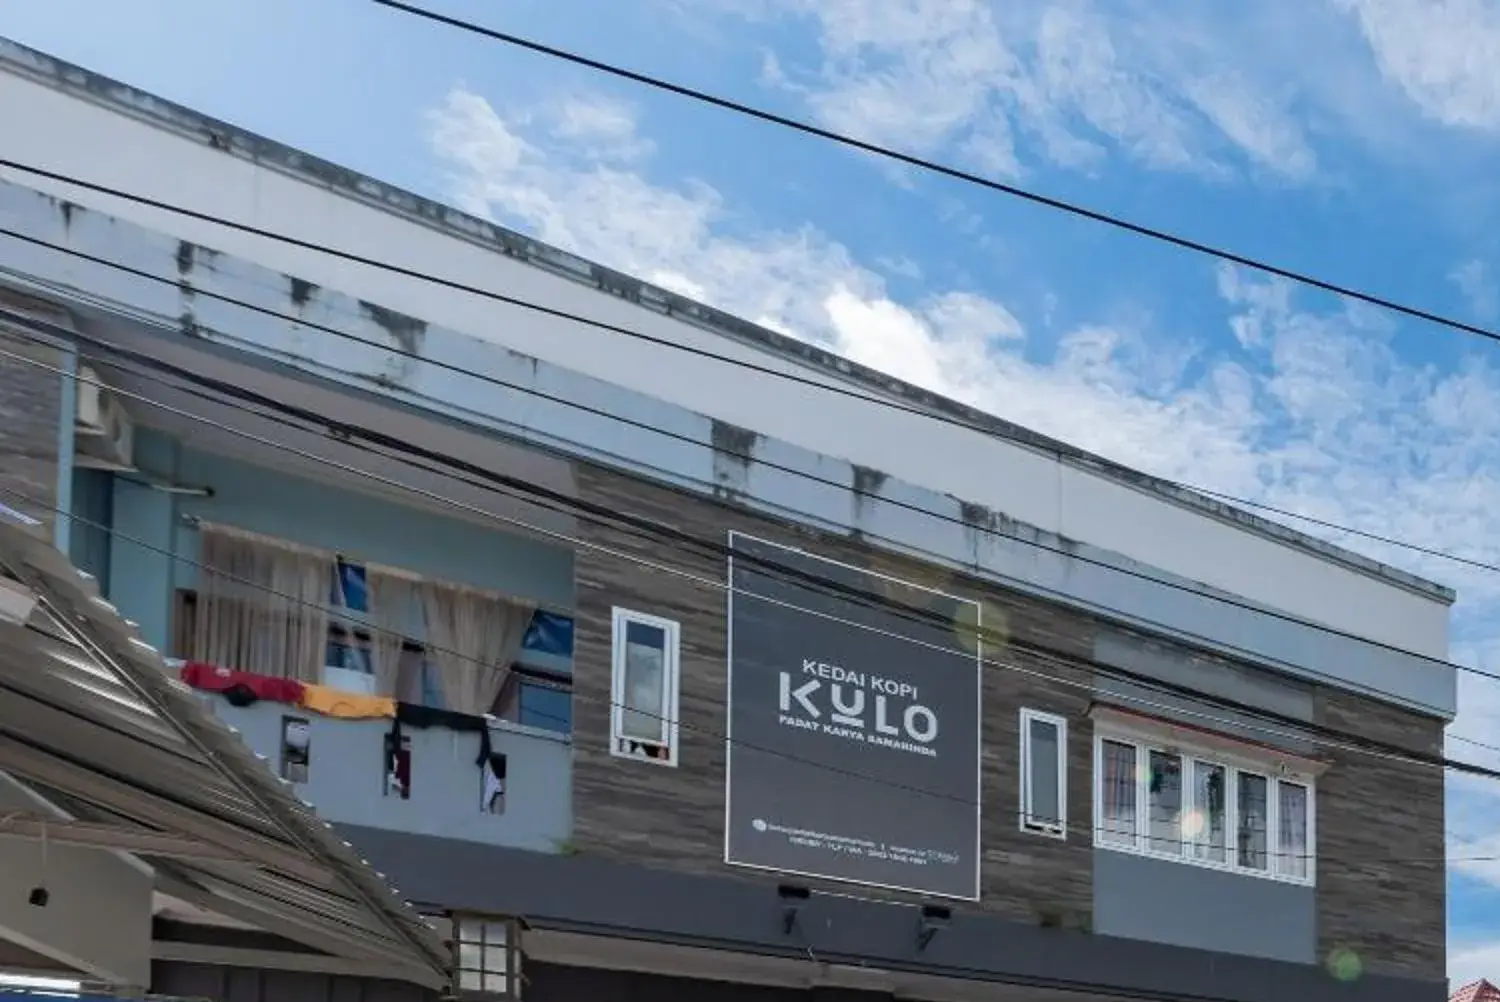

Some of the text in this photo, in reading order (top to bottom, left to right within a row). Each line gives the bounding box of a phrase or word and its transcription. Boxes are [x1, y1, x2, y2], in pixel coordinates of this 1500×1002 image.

[802, 659, 919, 701] KEDAI KOPI
[779, 671, 938, 743] KULO
[779, 714, 937, 757] PADAT KARYA SAMARINDA
